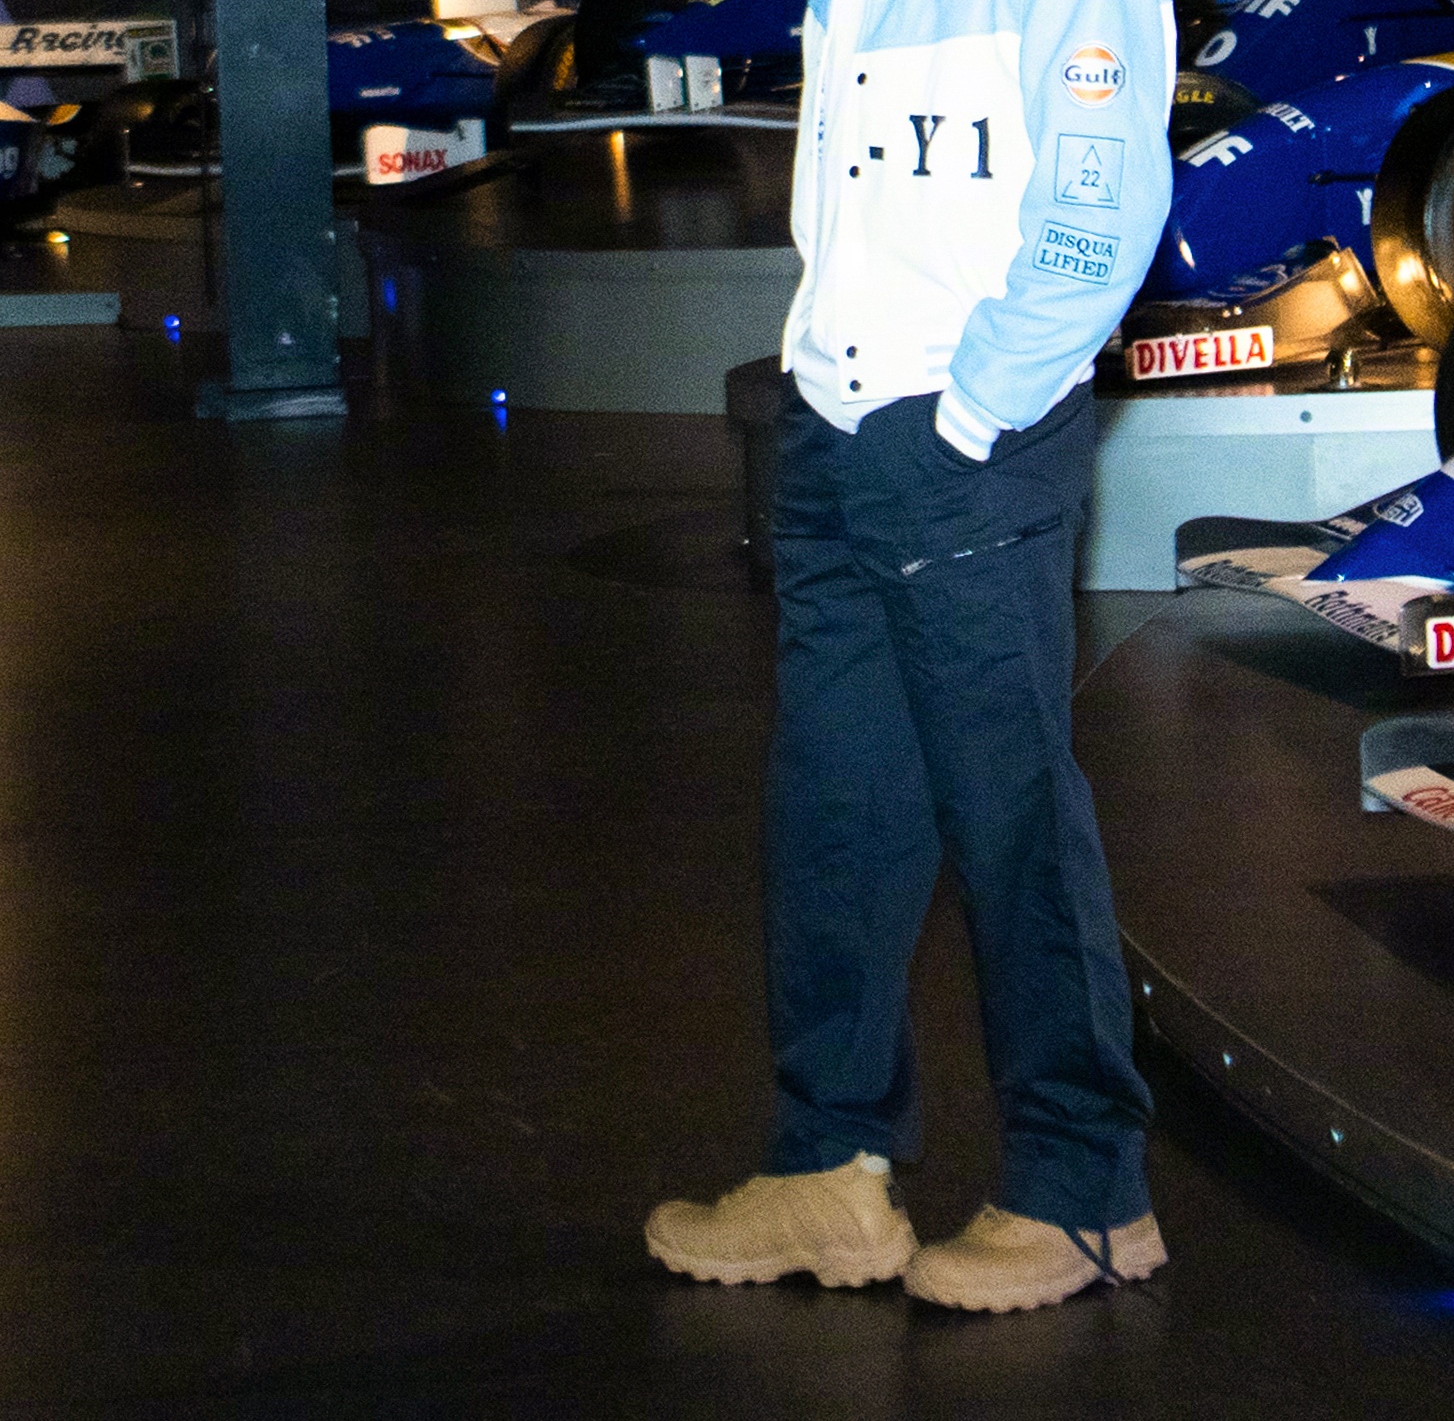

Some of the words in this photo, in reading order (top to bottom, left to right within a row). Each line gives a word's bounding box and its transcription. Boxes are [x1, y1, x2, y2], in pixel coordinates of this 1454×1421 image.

[1064, 64, 1122, 86] Gulf
[377, 148, 449, 175] SONAX
[1080, 168, 1102, 188] 22
[1045, 228, 1115, 259] DISQUA
[1039, 249, 1109, 280] LIFIED
[1135, 333, 1267, 376] DIVELLA
